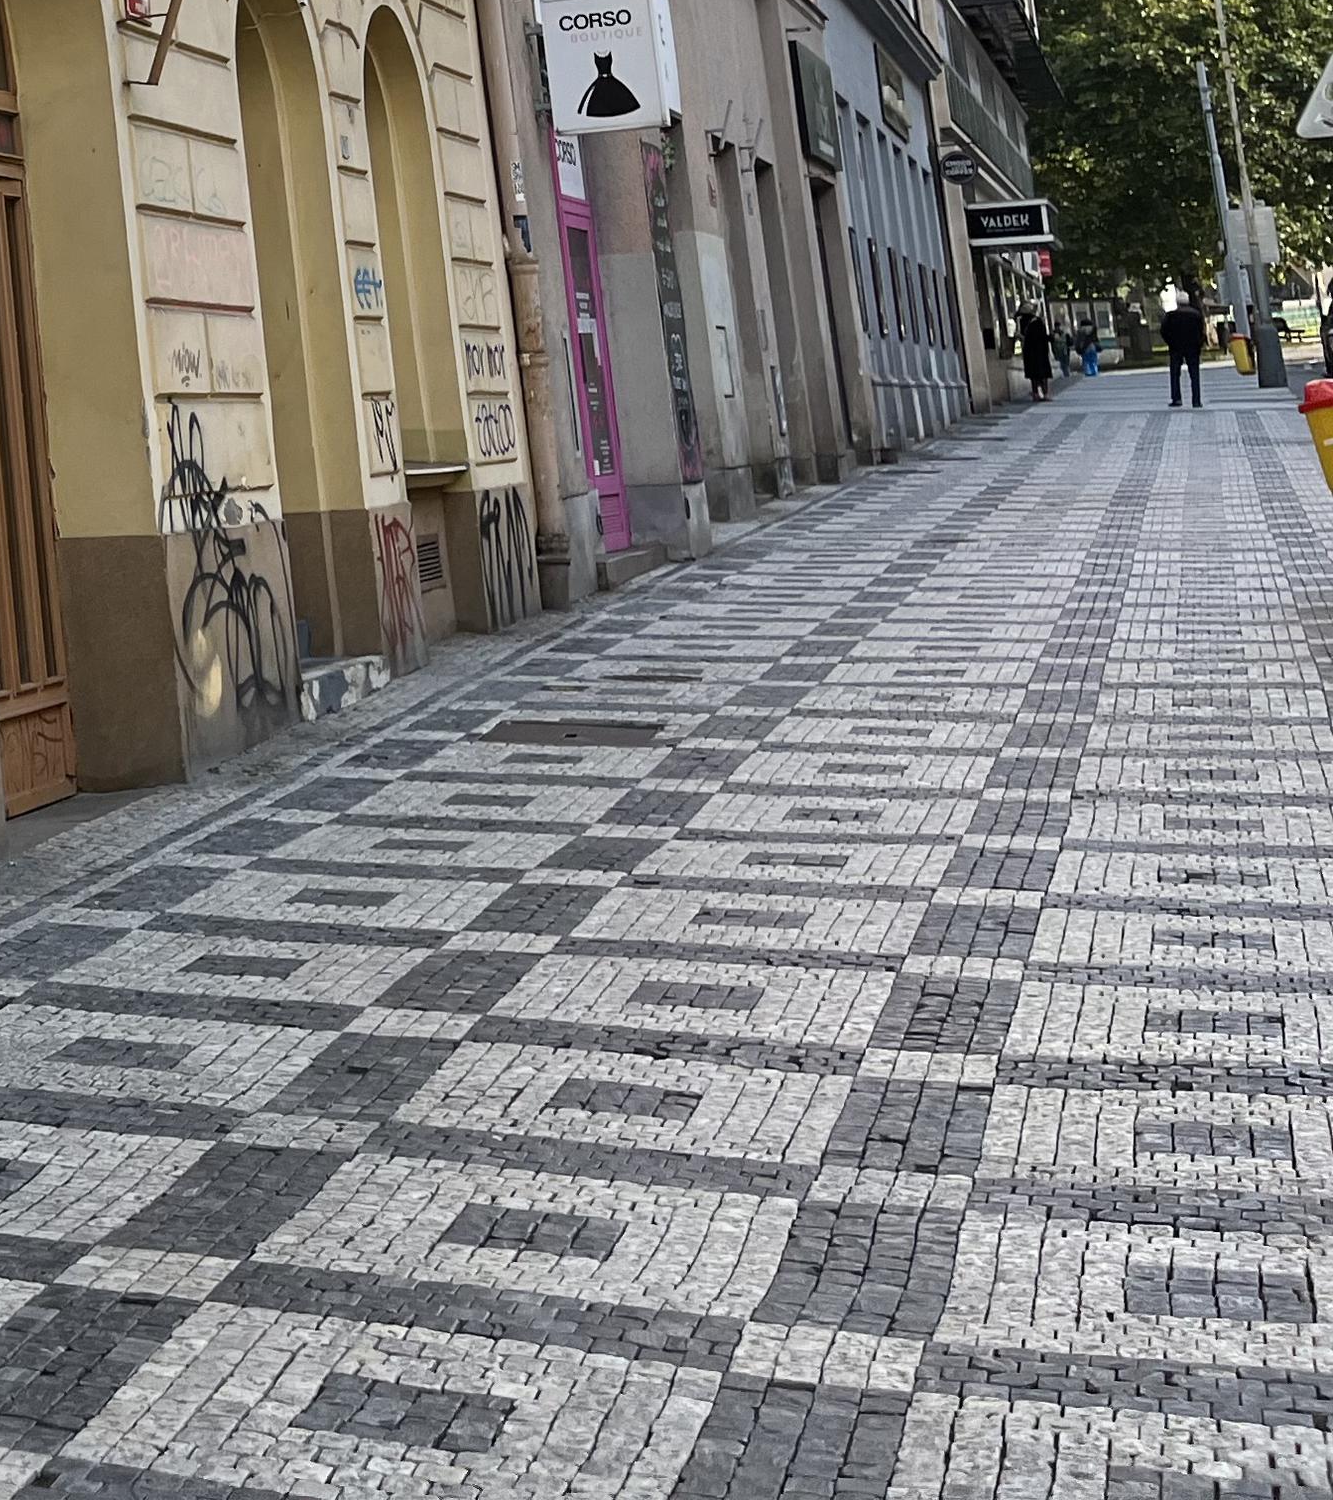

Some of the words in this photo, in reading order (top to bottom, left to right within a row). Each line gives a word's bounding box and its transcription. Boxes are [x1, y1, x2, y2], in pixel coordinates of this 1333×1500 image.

[559, 9, 632, 31] CORSO
[570, 26, 643, 43] BOUTIQUE
[980, 213, 1030, 228] VALDEK
